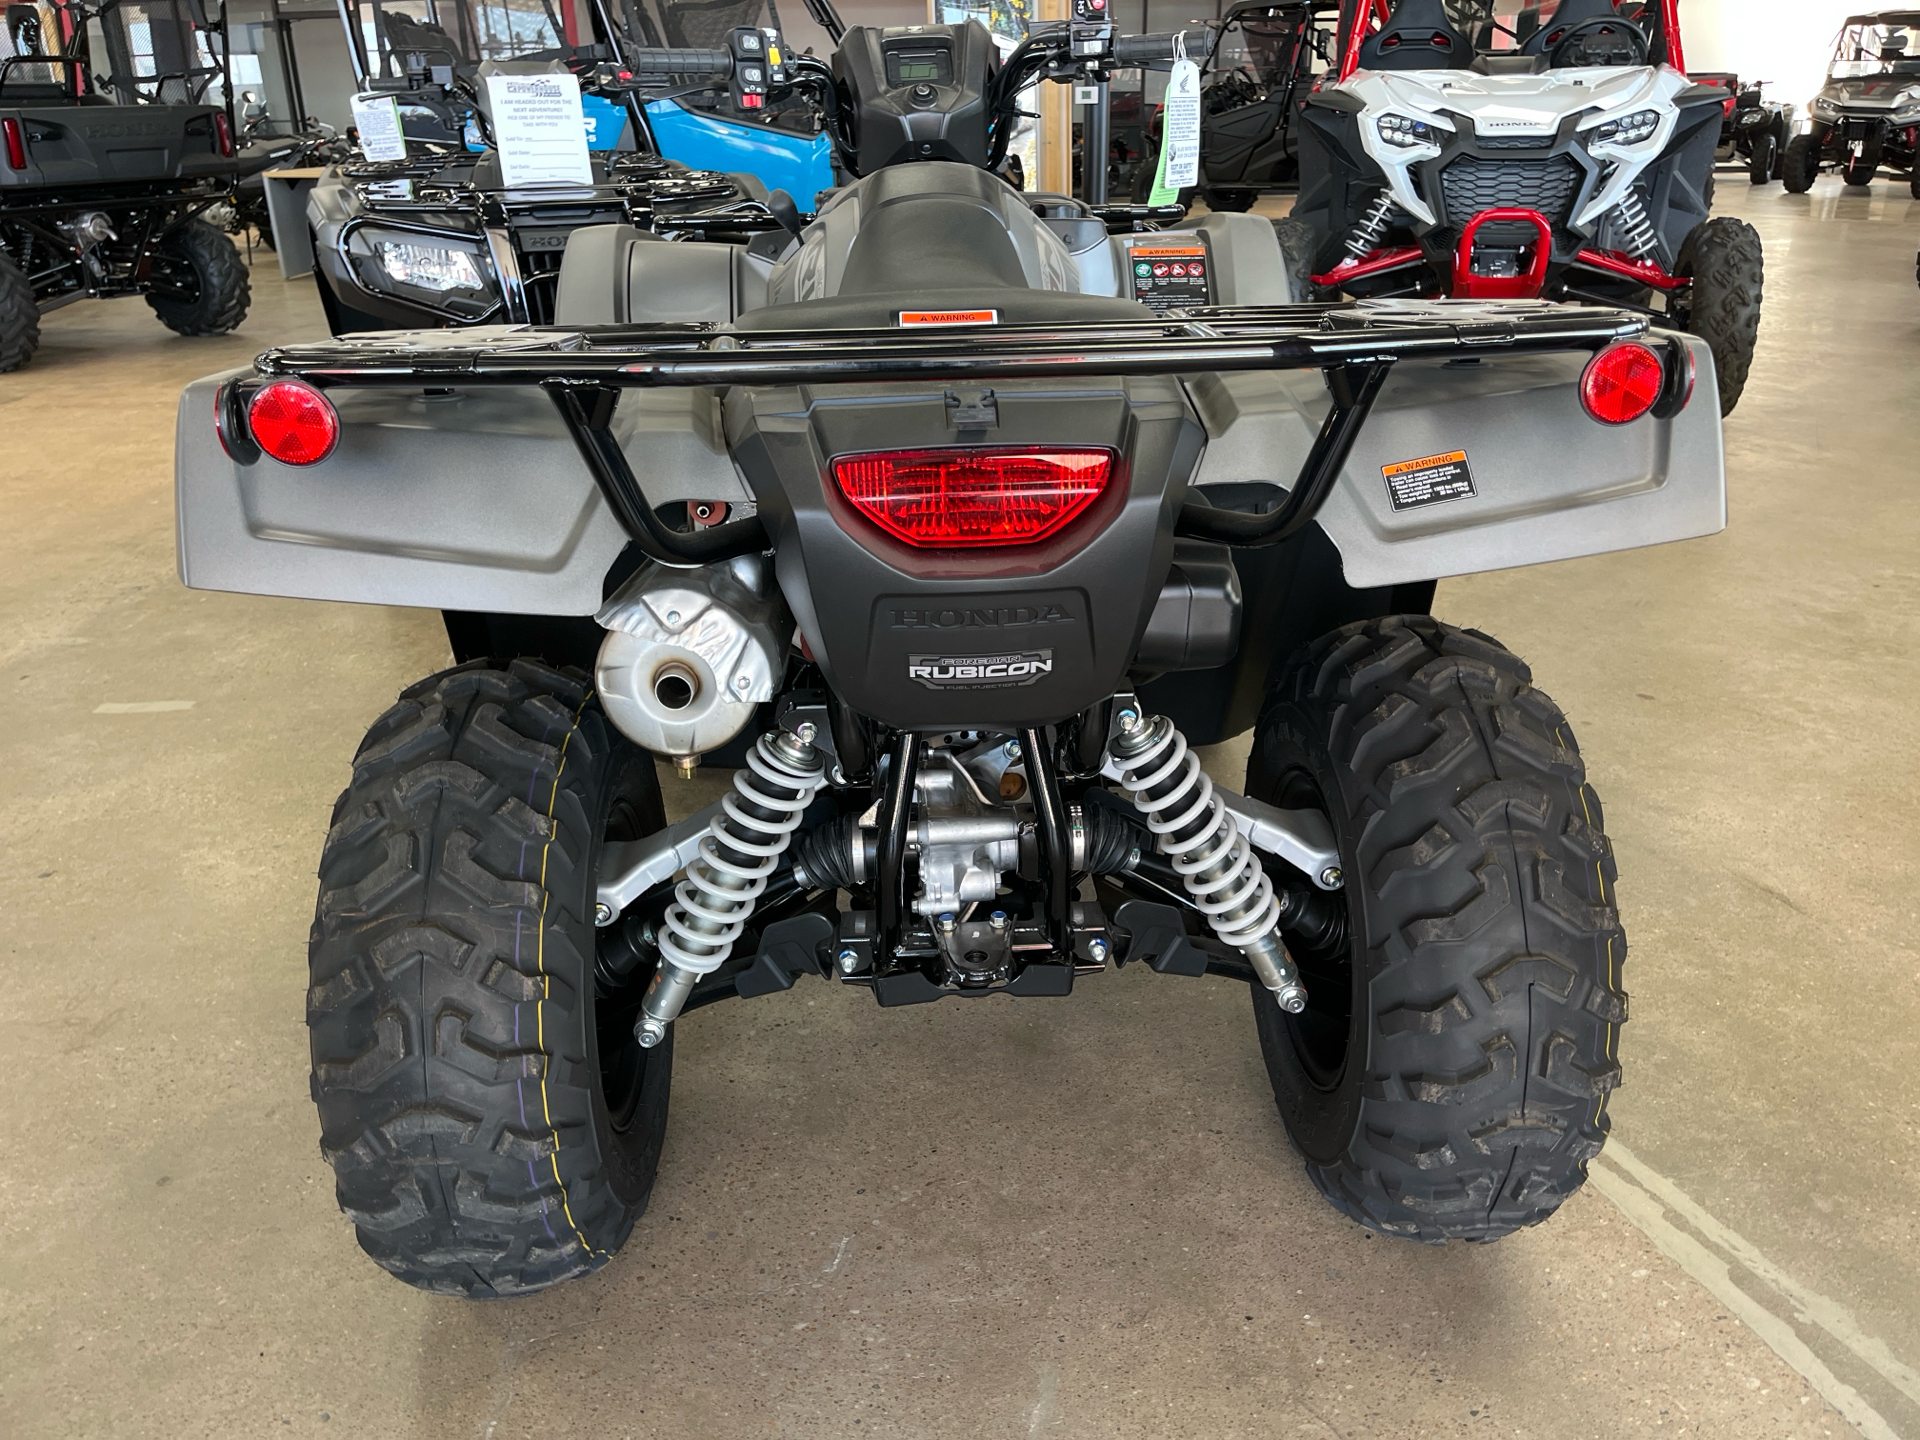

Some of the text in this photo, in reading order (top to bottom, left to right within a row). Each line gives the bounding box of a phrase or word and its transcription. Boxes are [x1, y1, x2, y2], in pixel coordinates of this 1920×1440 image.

[931, 314, 975, 322] WARNING
[1405, 455, 1453, 470] WARNING
[890, 604, 1075, 629] HONDA
[941, 655, 1021, 666] FOREMAN
[909, 659, 1053, 679] RUBICON
[972, 682, 1017, 690] INJECTION
